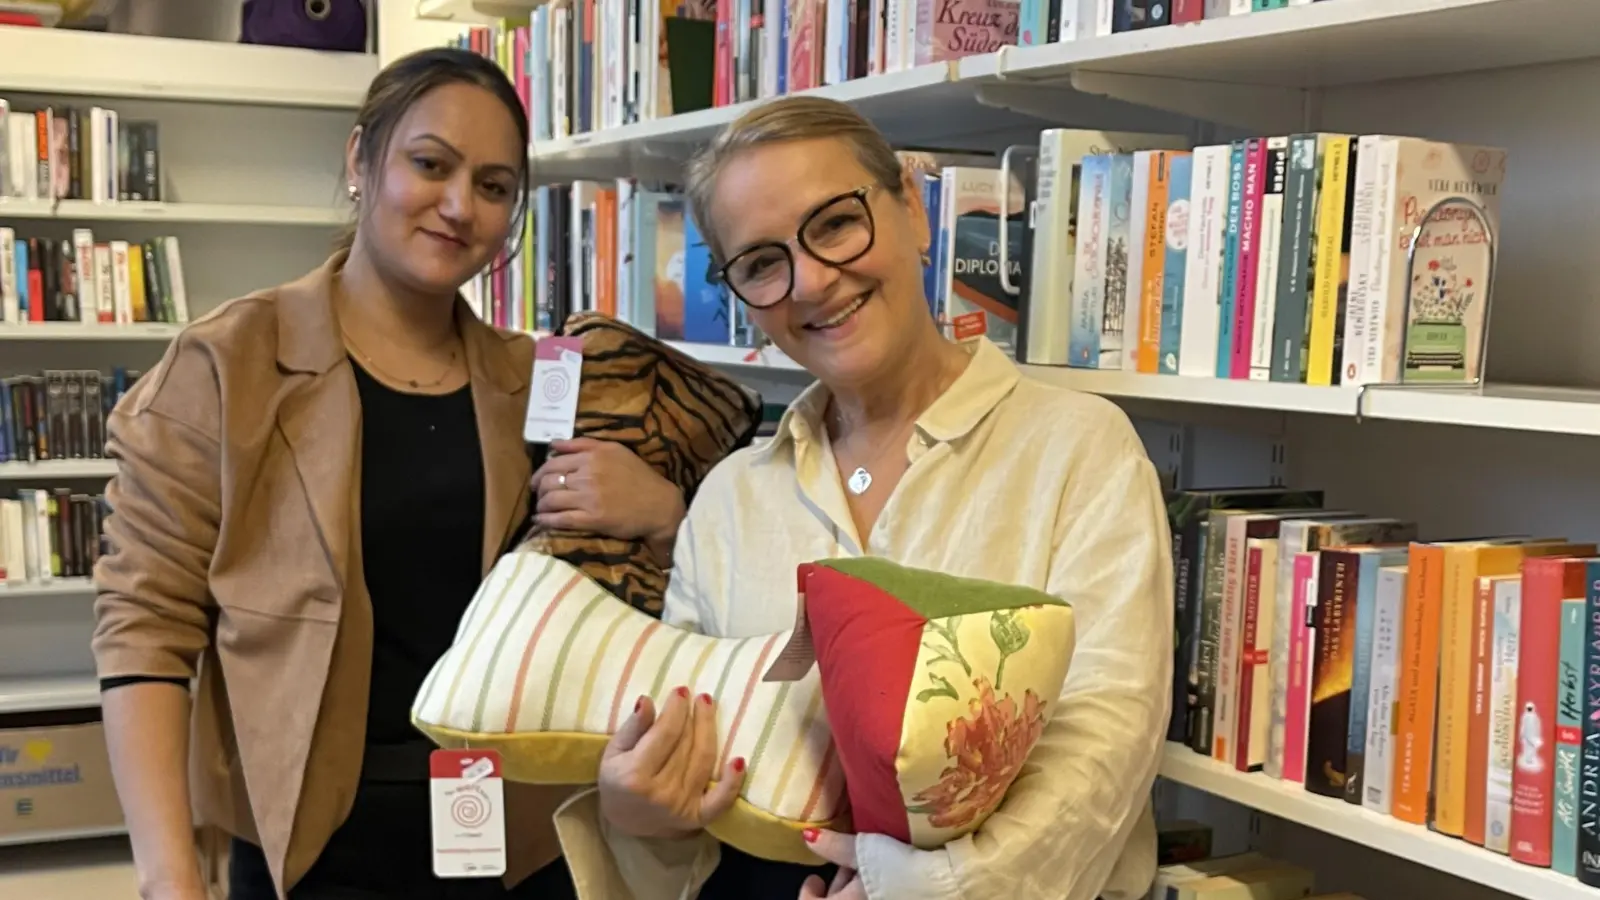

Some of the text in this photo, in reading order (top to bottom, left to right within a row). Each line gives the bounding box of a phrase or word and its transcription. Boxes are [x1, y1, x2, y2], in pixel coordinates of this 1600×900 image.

[936, 0, 1001, 27] Kreuz
[1230, 162, 1242, 202] BOSS
[1245, 163, 1257, 196] MAN
[1273, 151, 1286, 192] PIPER
[1228, 205, 1240, 234] DER
[1241, 199, 1255, 252] MACHO
[1332, 562, 1345, 633] LABYRINTH
[1559, 660, 1580, 721] Herbst
[1582, 733, 1600, 836] ANDREA
